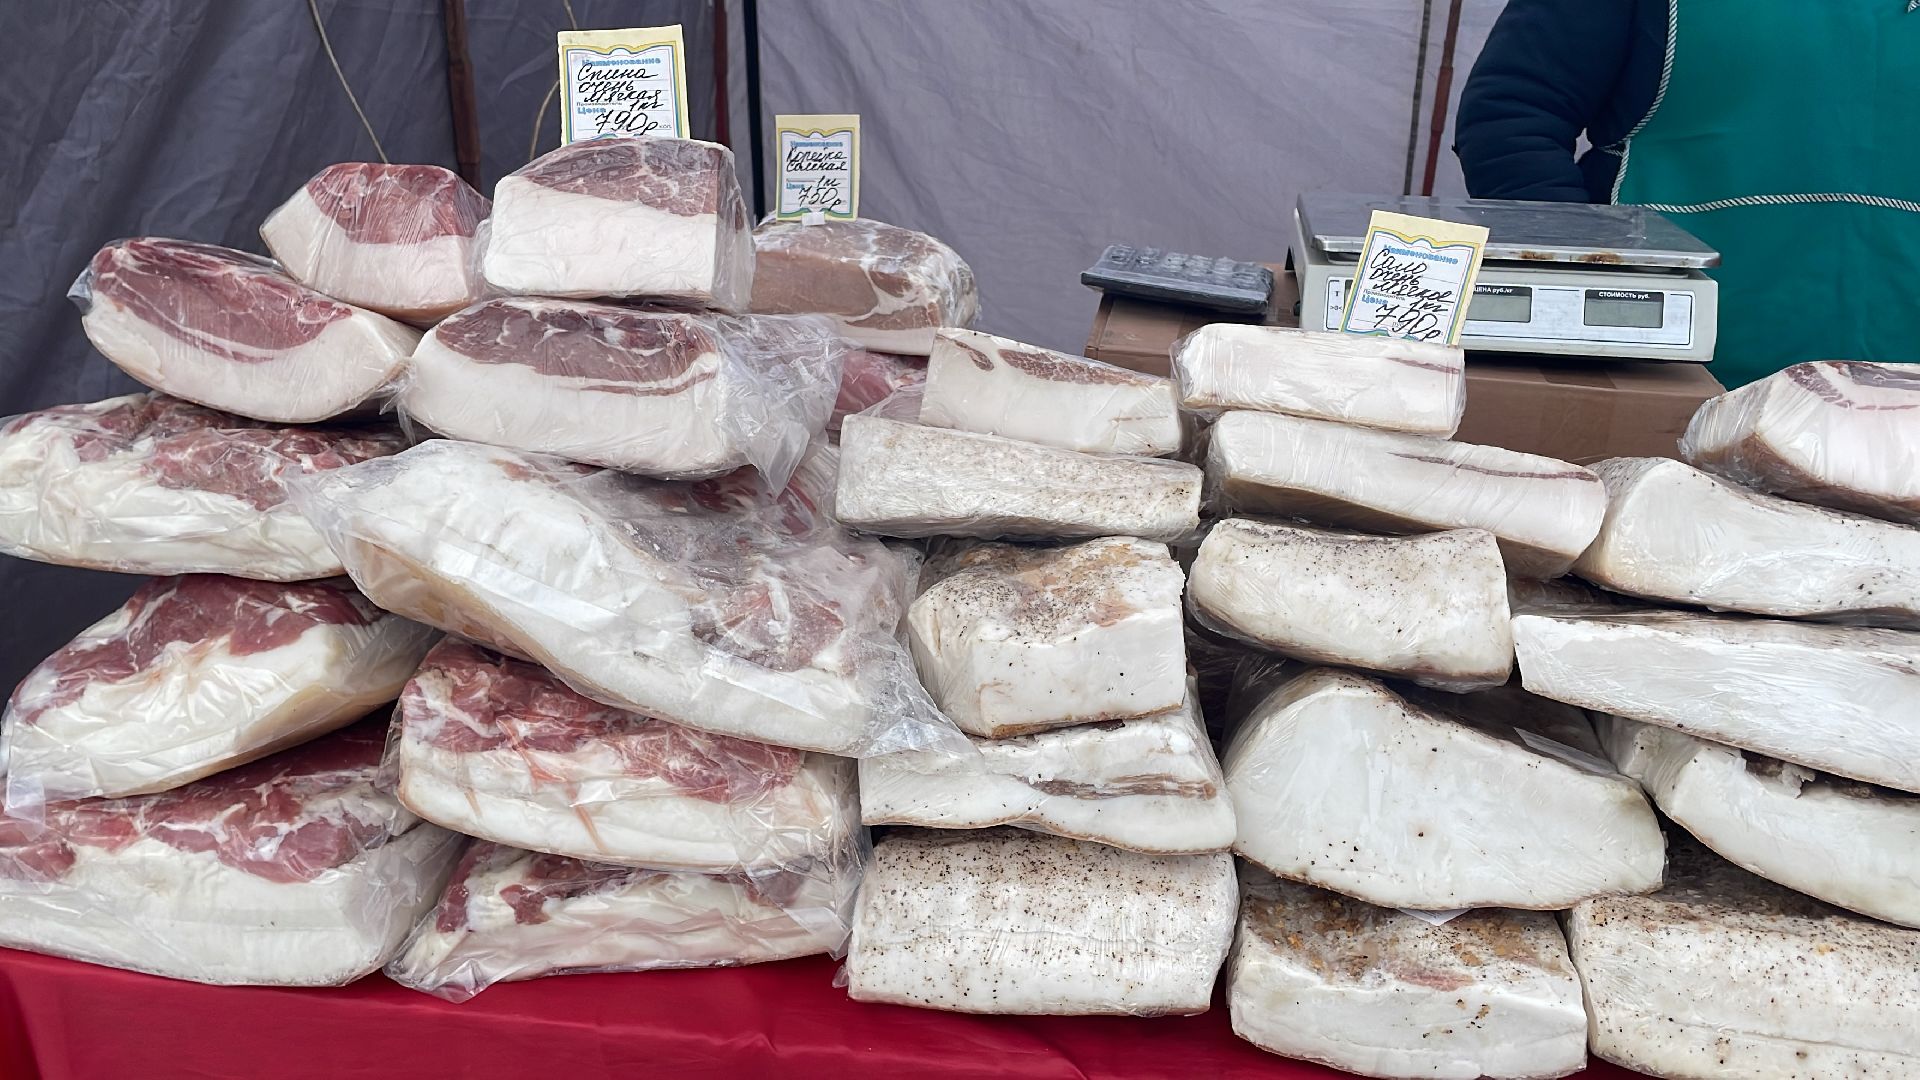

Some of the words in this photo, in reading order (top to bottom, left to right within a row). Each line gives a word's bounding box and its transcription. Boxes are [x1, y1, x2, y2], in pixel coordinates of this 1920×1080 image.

[578, 63, 658, 81] Спина
[1371, 248, 1427, 274] Сало
[1598, 291, 1637, 299] СТОИМОСТЬ
